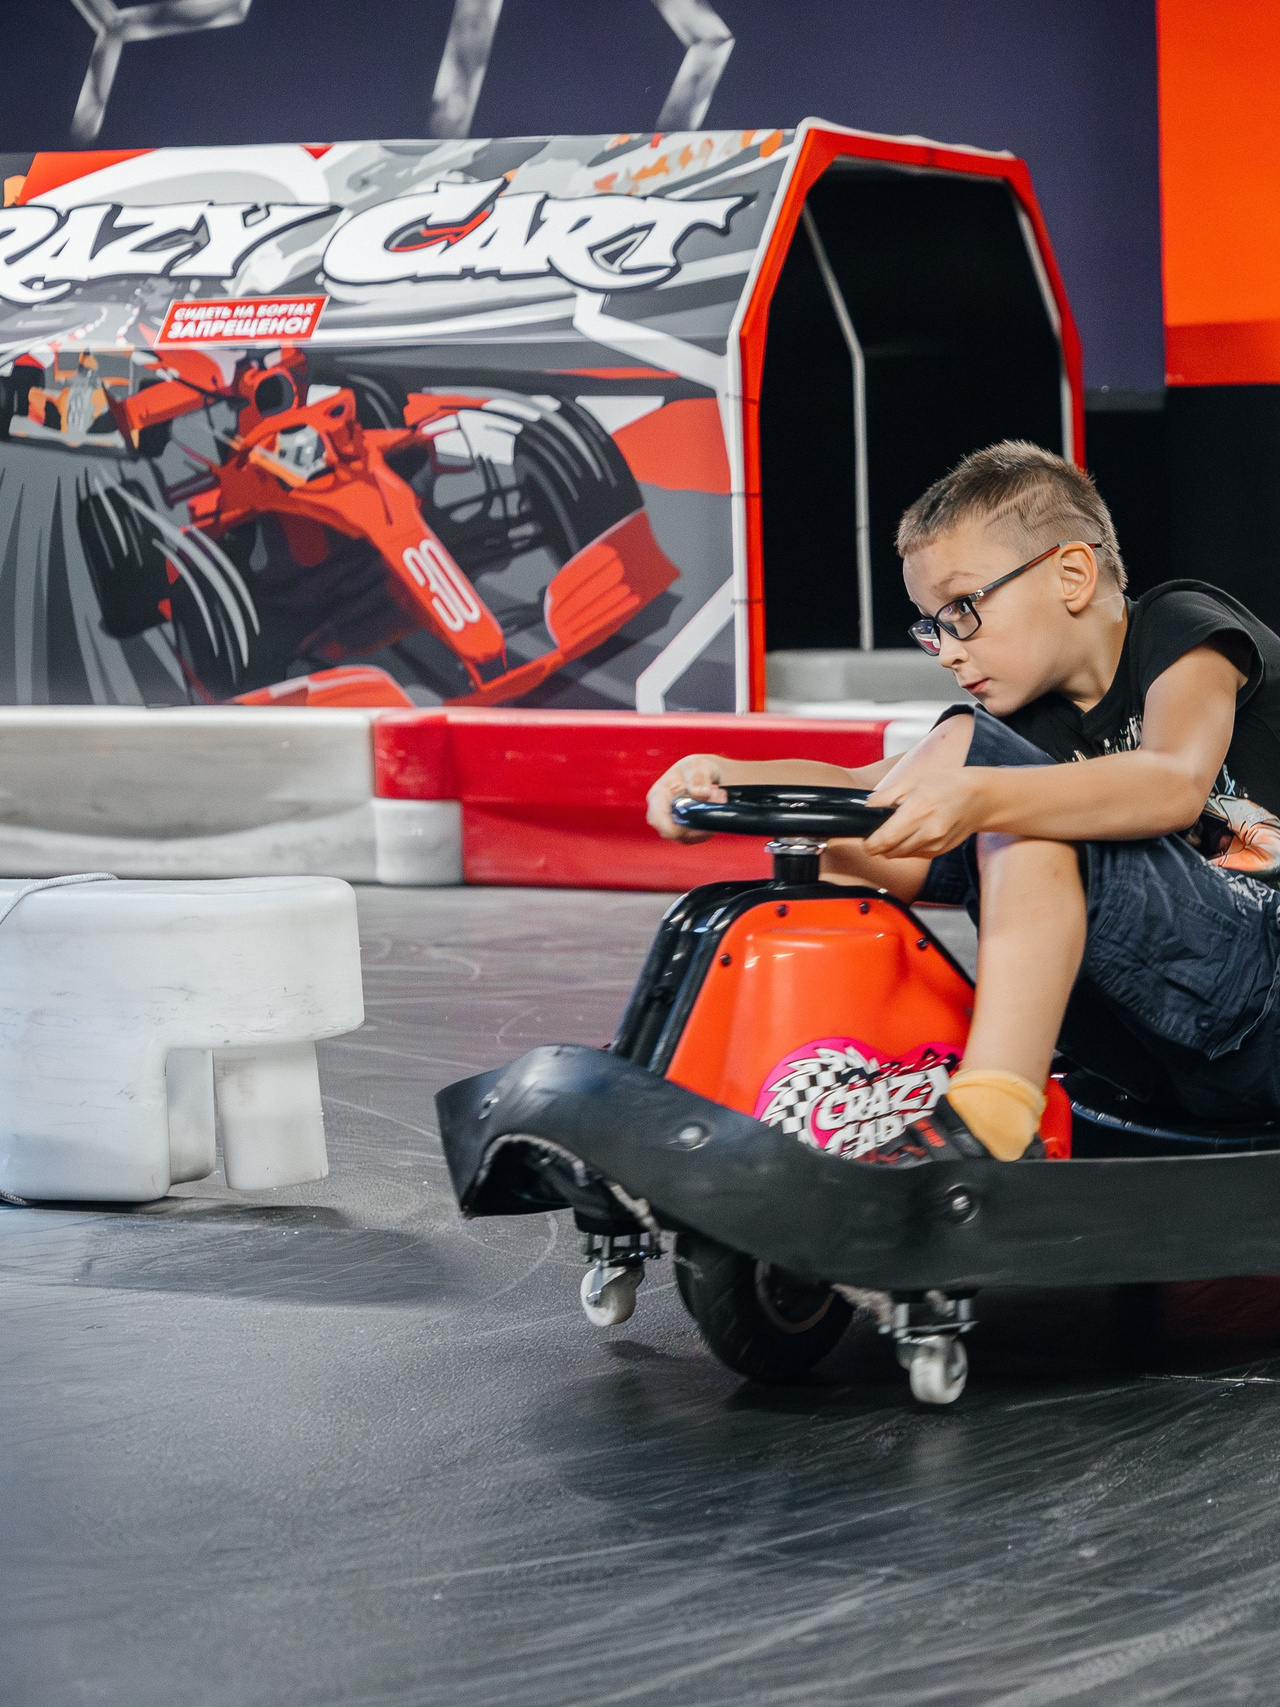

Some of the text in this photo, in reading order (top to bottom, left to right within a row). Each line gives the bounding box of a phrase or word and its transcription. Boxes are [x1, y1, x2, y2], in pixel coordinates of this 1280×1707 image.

[321, 176, 746, 290] CART
[167, 317, 311, 337] ЗАПРЕЩЕНО!
[174, 302, 316, 321] СИДЕТЬ НА БОРТАХ
[402, 539, 481, 632] 30
[815, 1064, 950, 1131] CRAZY
[823, 1110, 934, 1160] CAR
